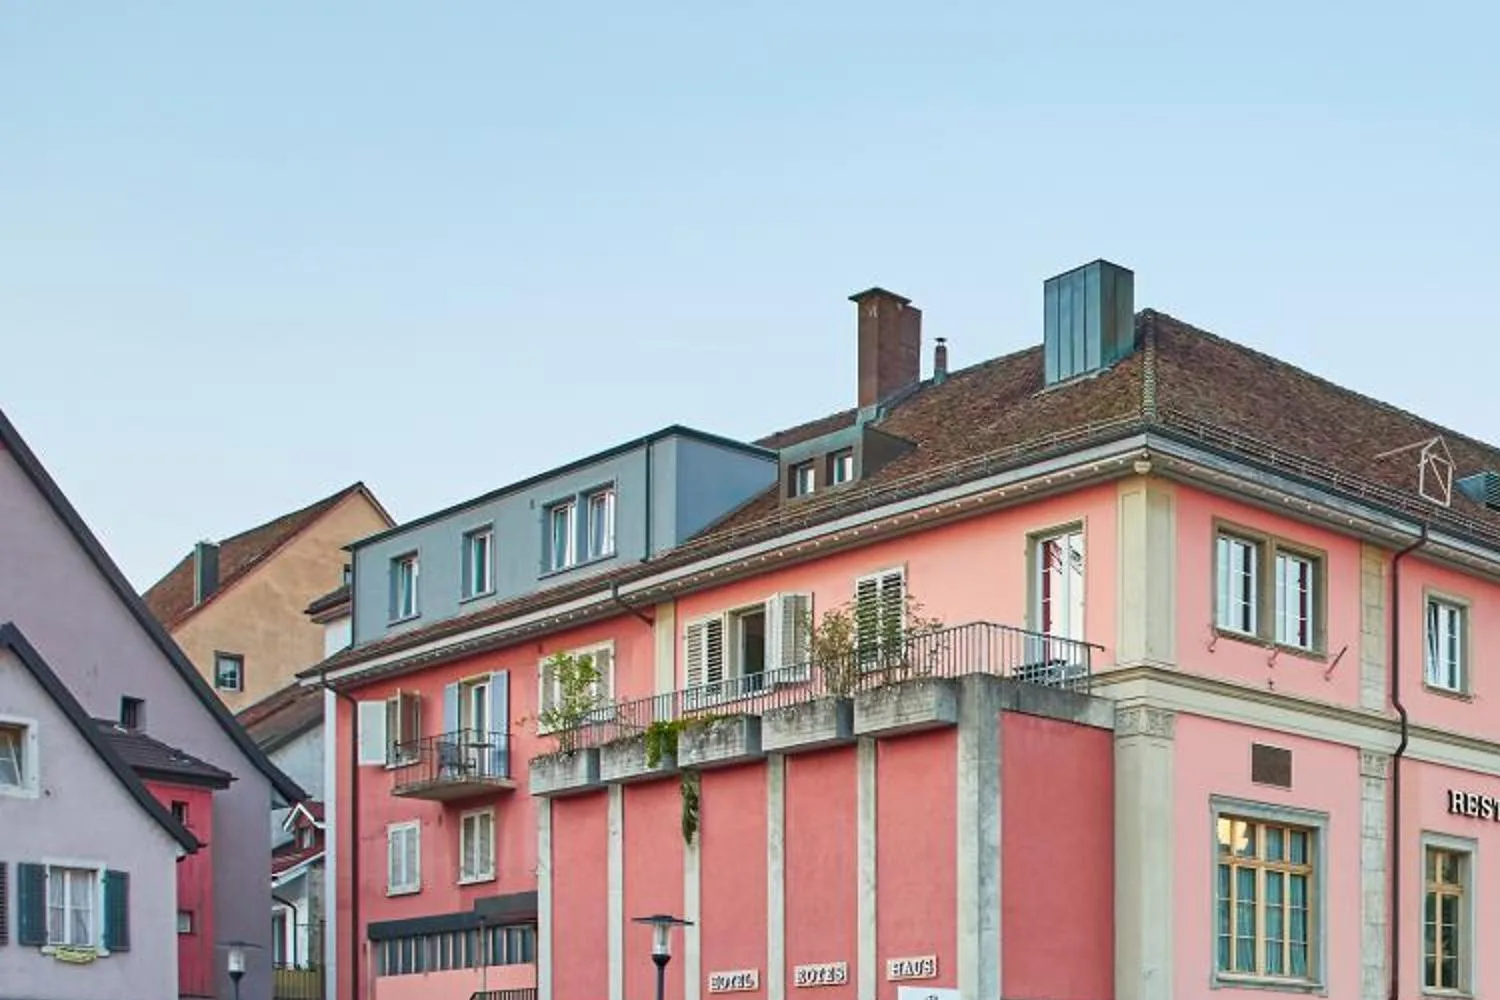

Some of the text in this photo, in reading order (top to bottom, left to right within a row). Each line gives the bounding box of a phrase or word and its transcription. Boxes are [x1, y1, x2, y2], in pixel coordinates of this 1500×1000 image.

[796, 966, 845, 986] ROTES
[890, 958, 935, 977] HAUS
[711, 974, 755, 991] HOTEL
